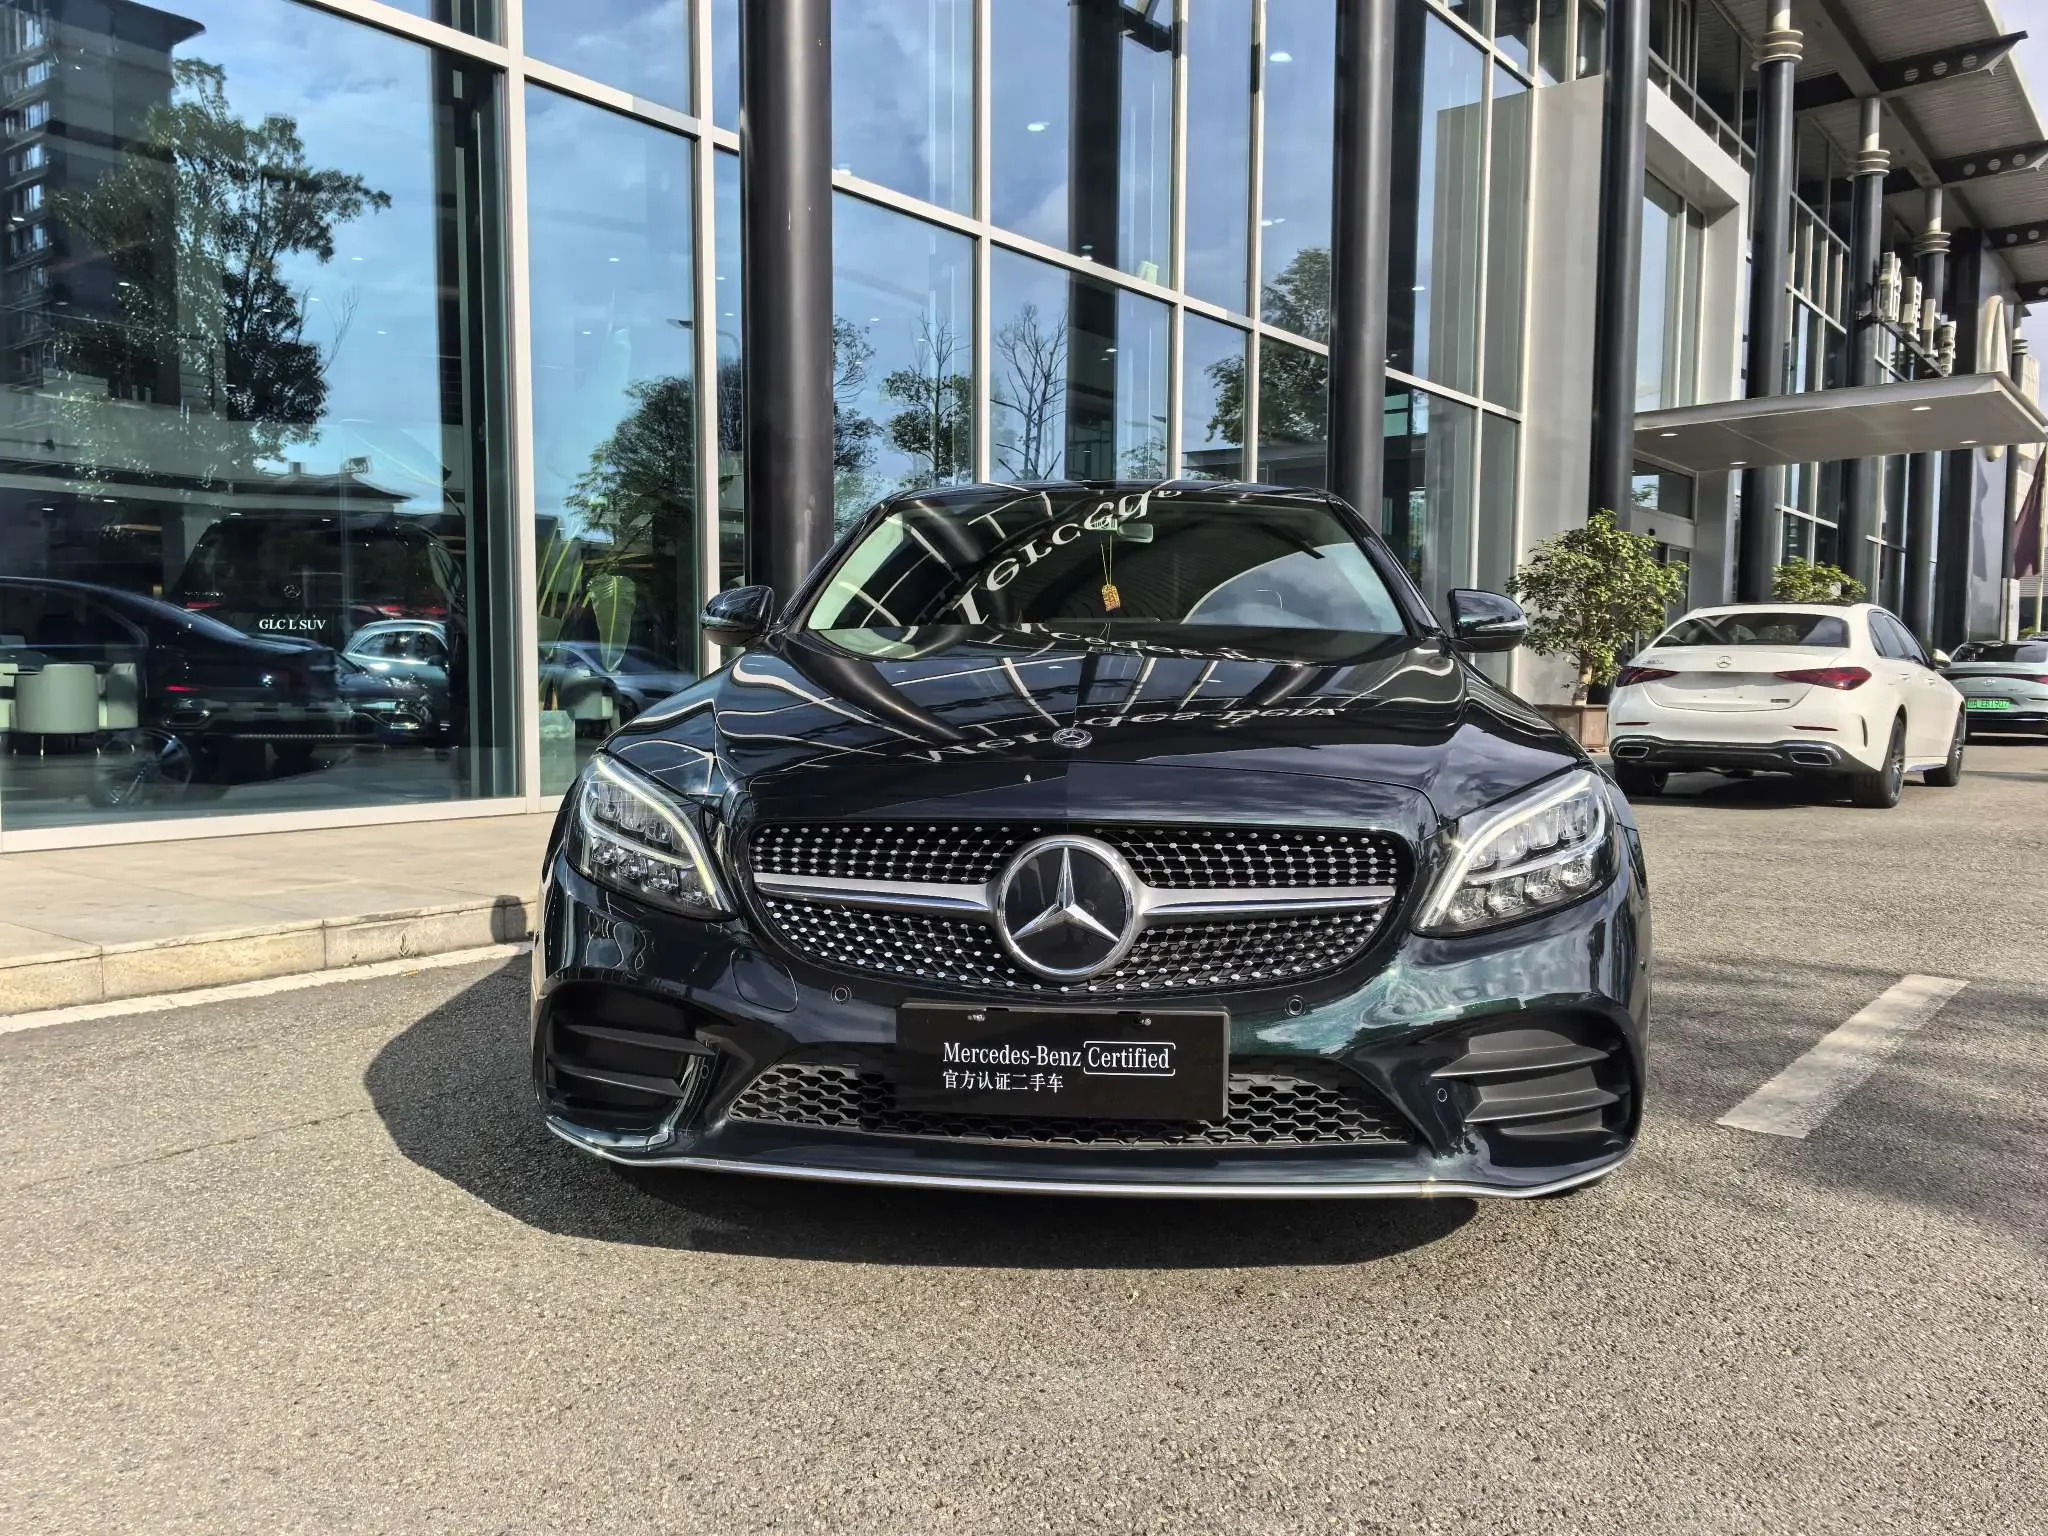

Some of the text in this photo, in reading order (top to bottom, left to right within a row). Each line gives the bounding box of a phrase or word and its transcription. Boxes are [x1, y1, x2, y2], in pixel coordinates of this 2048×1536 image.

[259, 619, 327, 630] GLC L SUV
[943, 1042, 1170, 1069] Mercedes-Benz Certified
[943, 1069, 1064, 1094] 官方认证二手车
